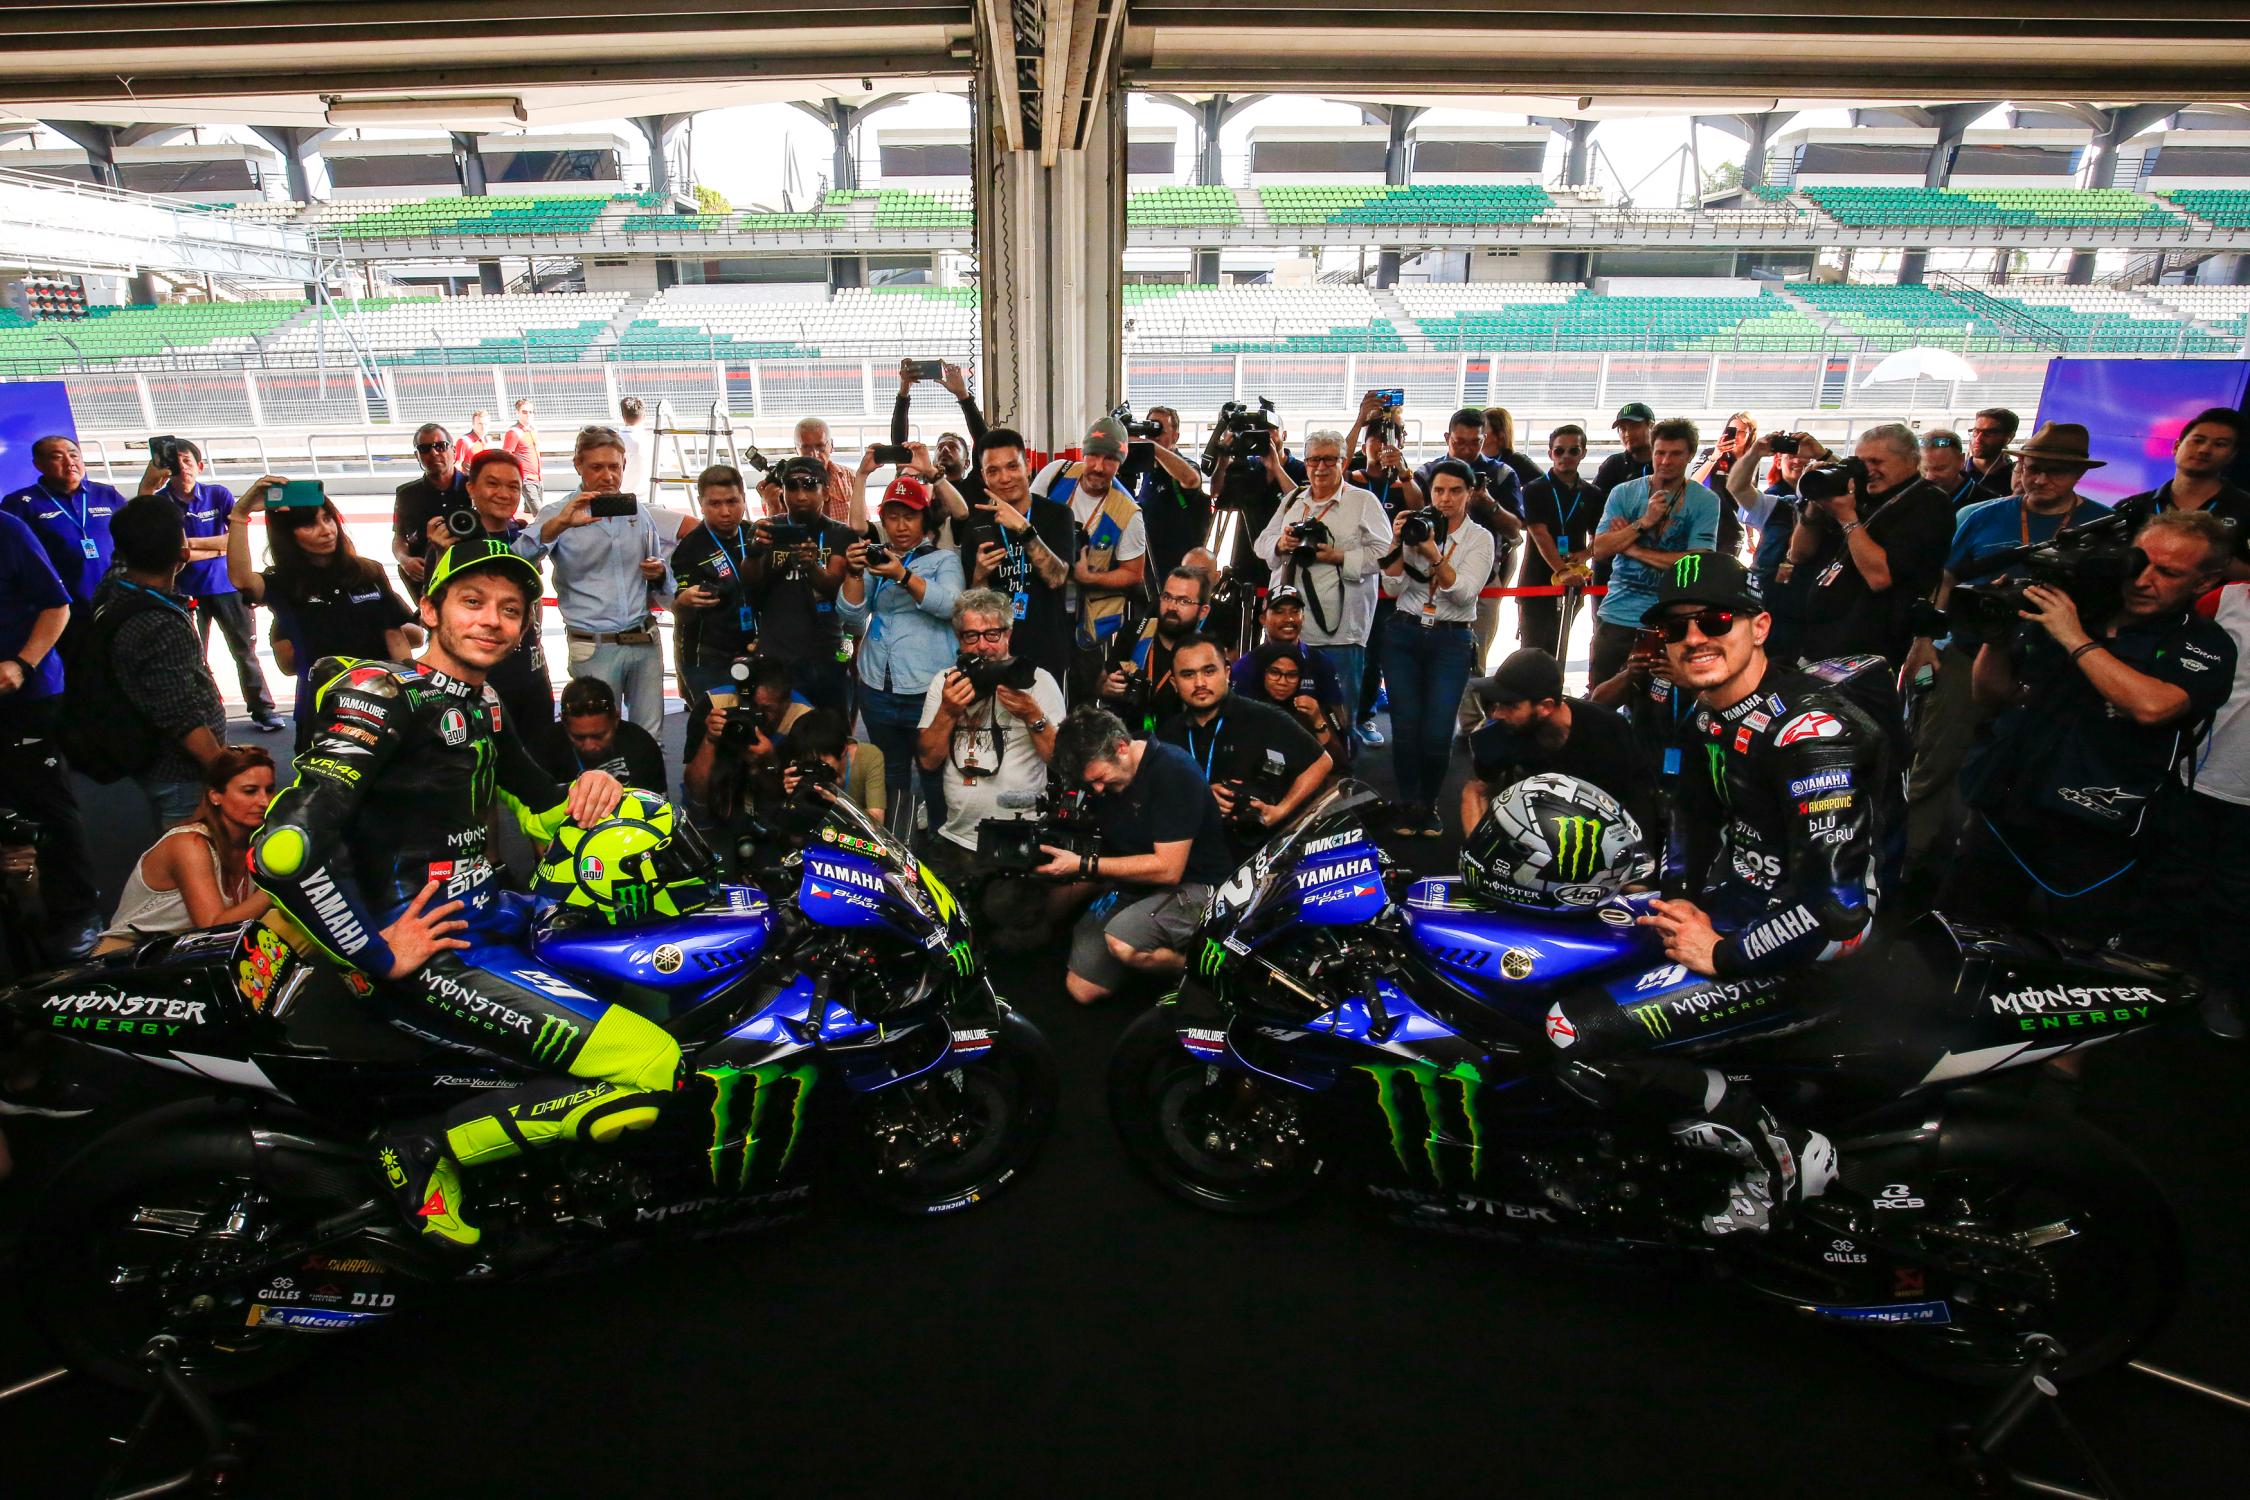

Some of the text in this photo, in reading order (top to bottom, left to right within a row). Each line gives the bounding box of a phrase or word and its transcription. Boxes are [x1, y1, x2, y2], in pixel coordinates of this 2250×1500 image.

[339, 696, 386, 719] YAMALUBE
[1722, 694, 1763, 721] YAMAHA
[1802, 774, 1849, 791] YAMAHA
[583, 870, 602, 880] agv
[811, 861, 885, 893] YAMAHA
[1297, 858, 1372, 889] YAMAHA
[300, 866, 370, 957] YAMAHA
[1744, 904, 1820, 960] YAMAHA
[43, 991, 206, 1024] MONSTER
[419, 968, 533, 1035] MONSTER
[1989, 984, 2167, 1015] MONSTER
[52, 1015, 180, 1037] ENERGY
[426, 995, 509, 1036] ENERGY
[2018, 1006, 2150, 1031] ENERGY
[952, 1028, 989, 1042] YAMALUBE
[1188, 1028, 1226, 1042] YAMALUBE
[531, 1081, 606, 1116] DAINESE
[1873, 1198, 1925, 1210] RCB
[1823, 1252, 1868, 1264] GILLES
[258, 1289, 300, 1301] GILLES
